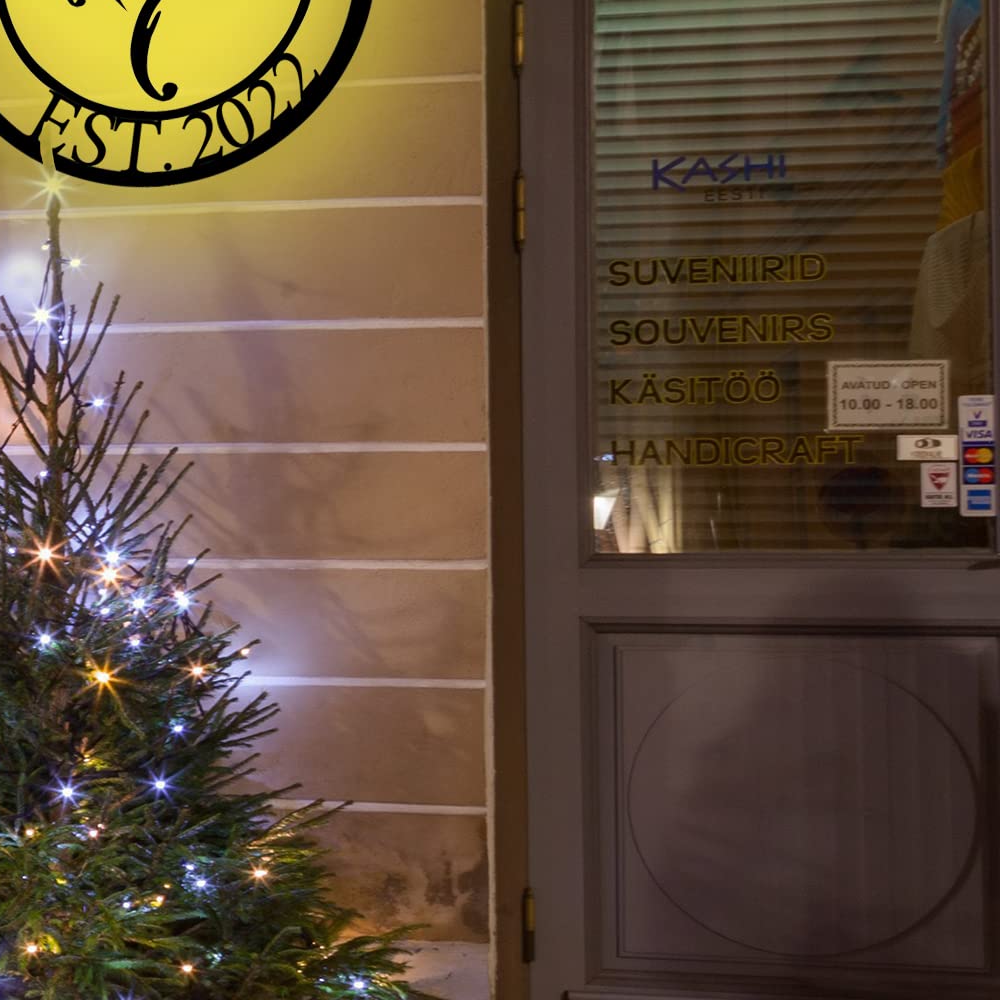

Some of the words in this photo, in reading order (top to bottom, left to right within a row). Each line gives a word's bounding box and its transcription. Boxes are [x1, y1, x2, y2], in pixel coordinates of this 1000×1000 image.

[652, 152, 786, 192] KASHI
[607, 252, 828, 288] SUVENIIRID
[608, 311, 836, 347] SOUVENIRS
[609, 369, 782, 406] KÄSITÖÖ
[841, 381, 891, 390] AVATUD
[901, 380, 937, 390] OPEN
[840, 398, 881, 410] 10.00
[896, 398, 938, 410] 18.00
[610, 433, 865, 468] HANDICRAFT
[966, 430, 992, 439] VISA
